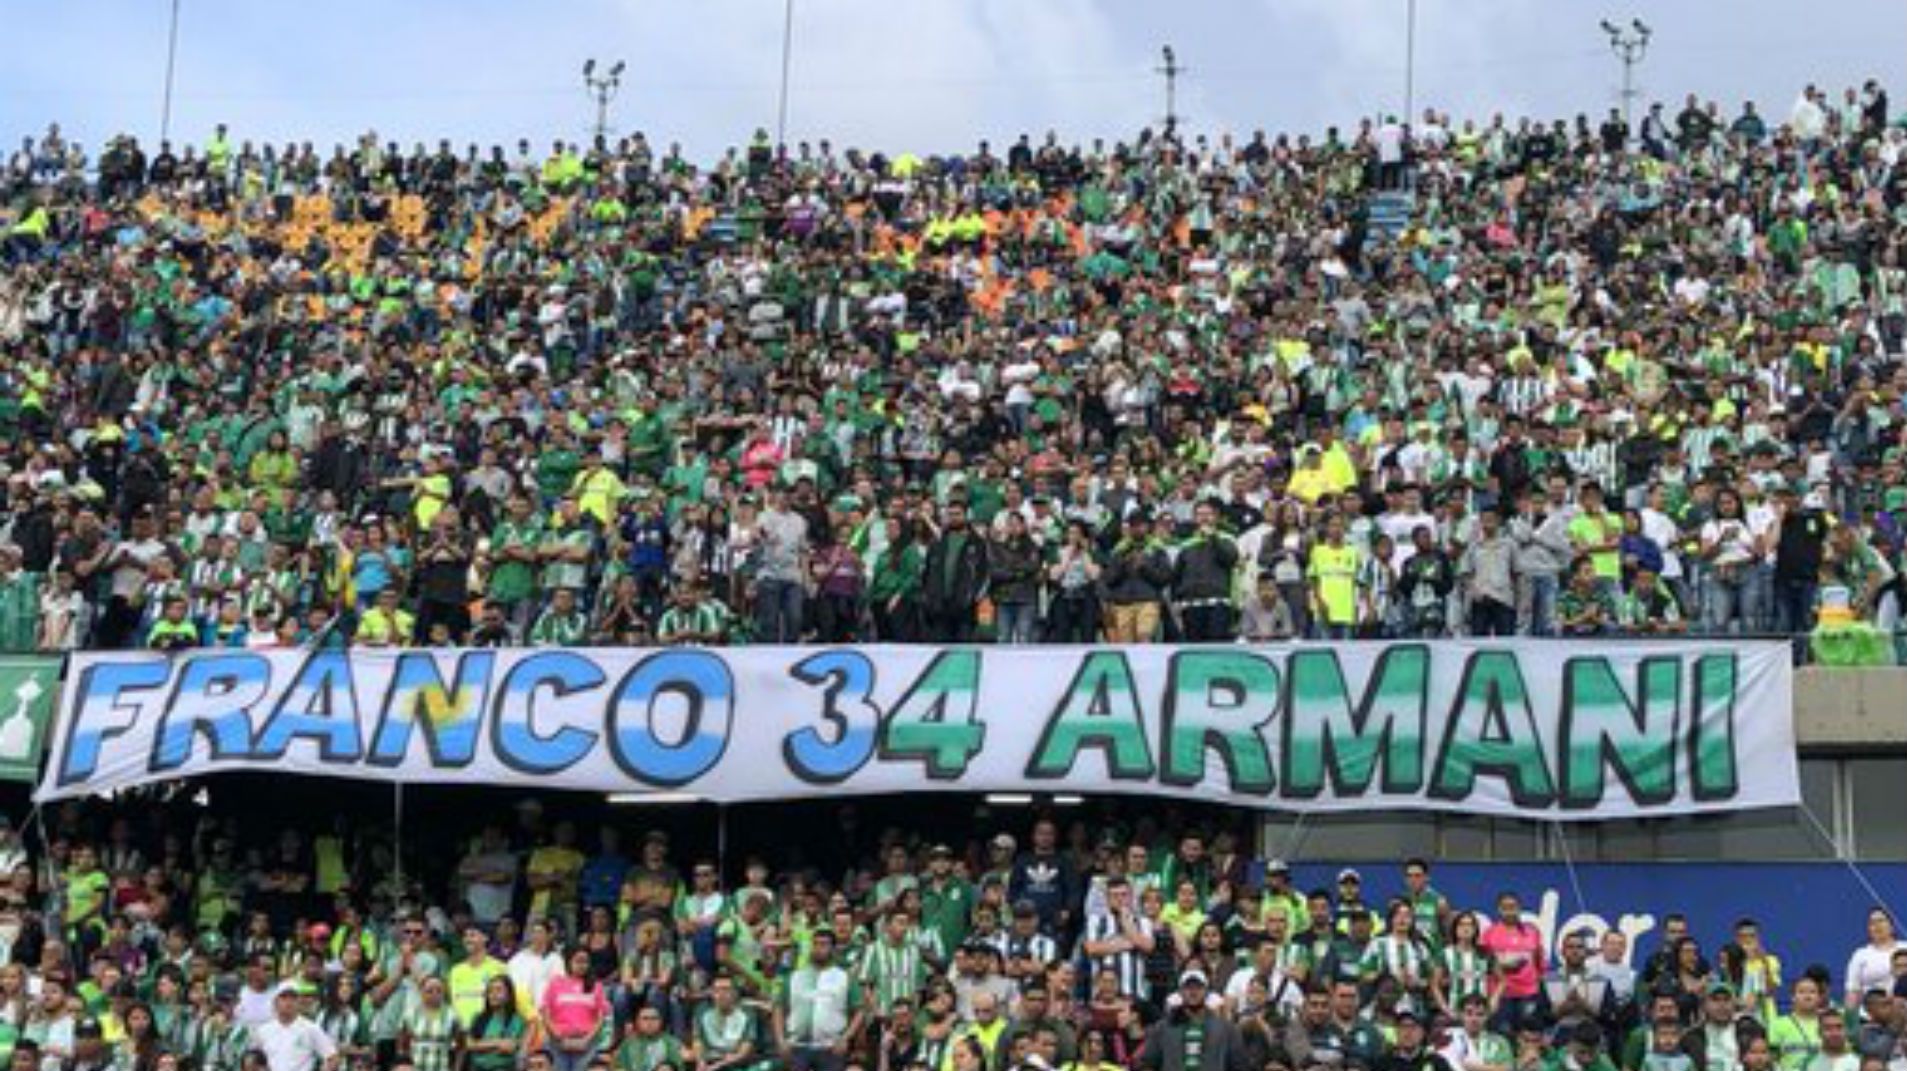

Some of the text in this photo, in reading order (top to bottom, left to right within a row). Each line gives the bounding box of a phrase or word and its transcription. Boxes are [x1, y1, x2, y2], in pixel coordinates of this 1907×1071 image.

[56, 643, 1738, 809] FRANCO 34 ARMANI
